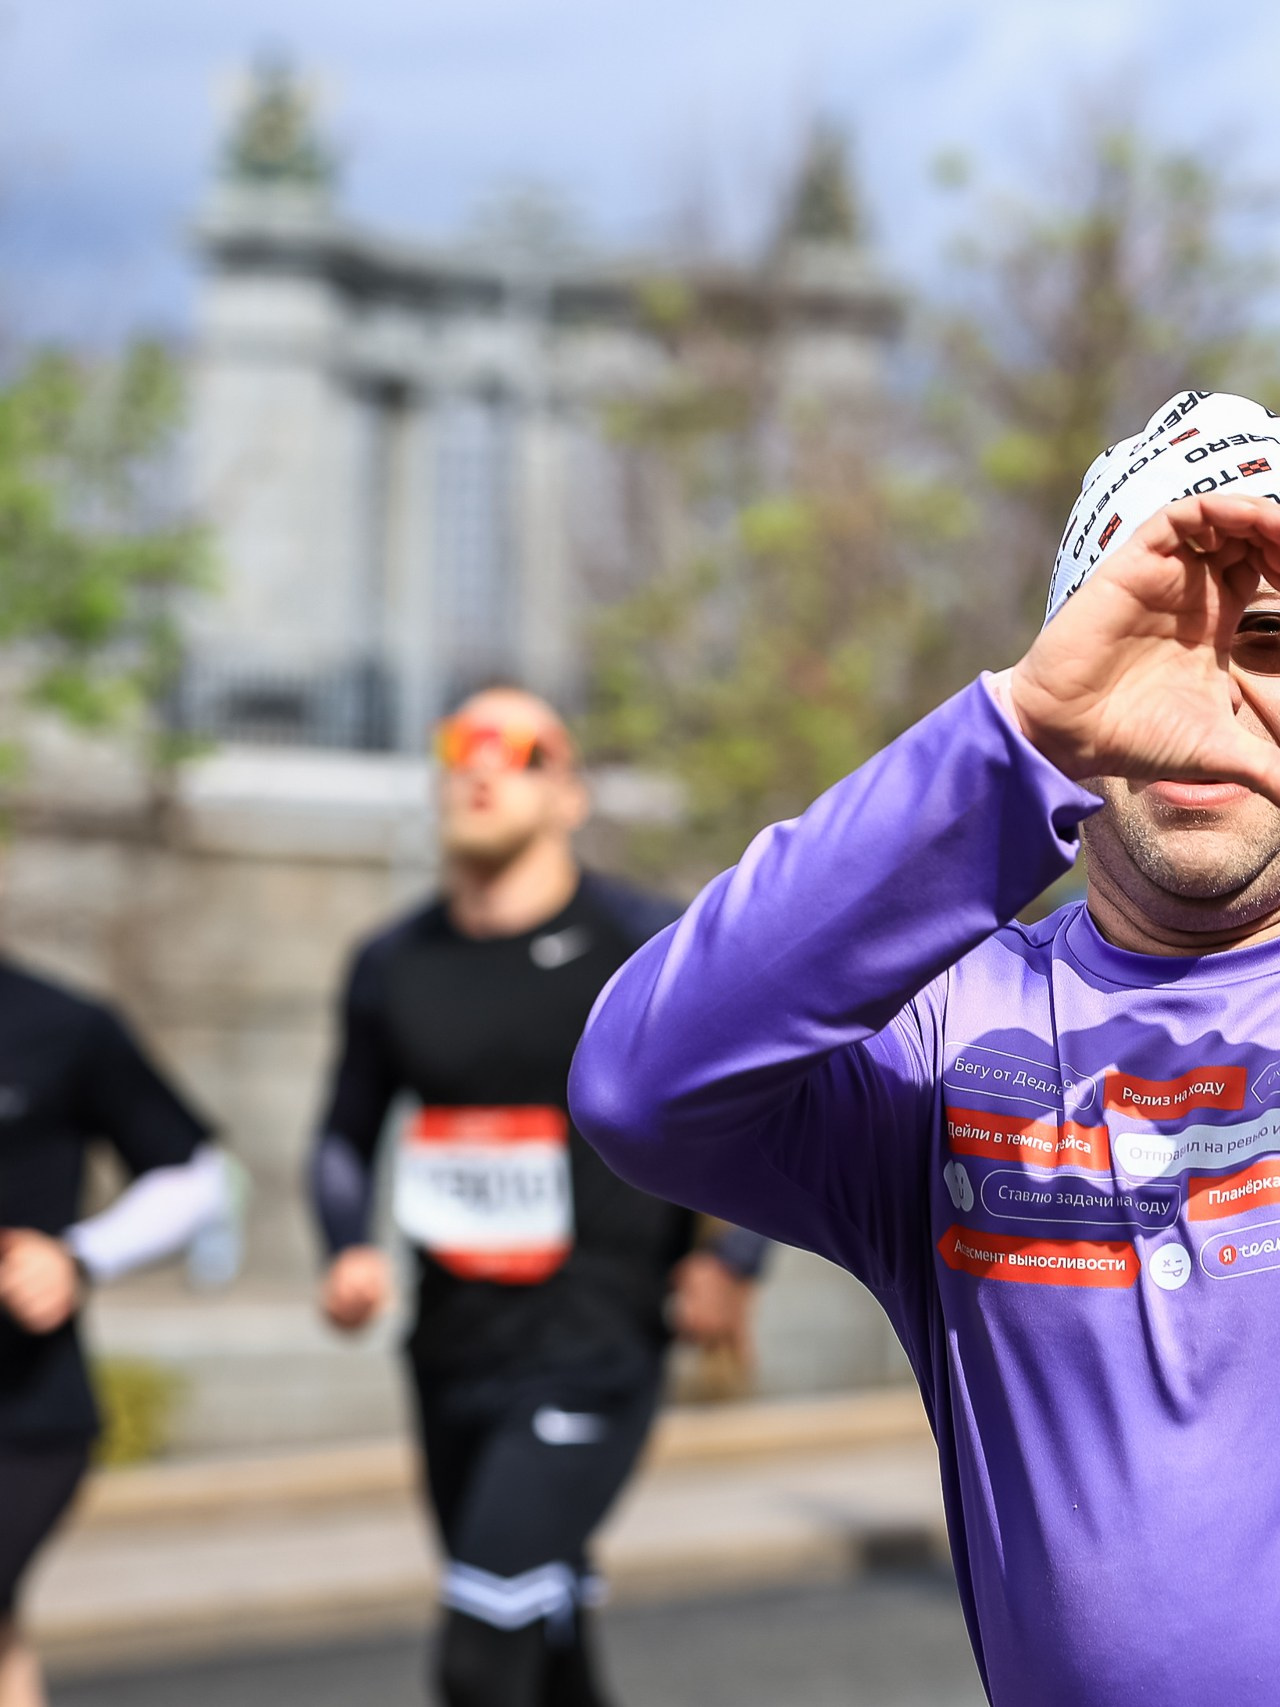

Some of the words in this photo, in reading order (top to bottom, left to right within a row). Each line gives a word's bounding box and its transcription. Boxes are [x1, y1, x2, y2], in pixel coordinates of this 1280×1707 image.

[954, 1057, 990, 1080] Бегу
[993, 1068, 1011, 1081] от
[1122, 1087, 1170, 1106] Релиз
[1174, 1090, 1188, 1105] на
[1188, 1082, 1225, 1097] ходу
[947, 1121, 990, 1141] Дейли
[994, 1132, 1002, 1143] в
[1006, 1133, 1053, 1153] темпе
[1204, 1142, 1223, 1153] на
[1227, 1126, 1269, 1154] ревью
[998, 1184, 1052, 1204] Ставлю
[1056, 1193, 1113, 1208] задачи
[1008, 1252, 1126, 1271] выносливости
